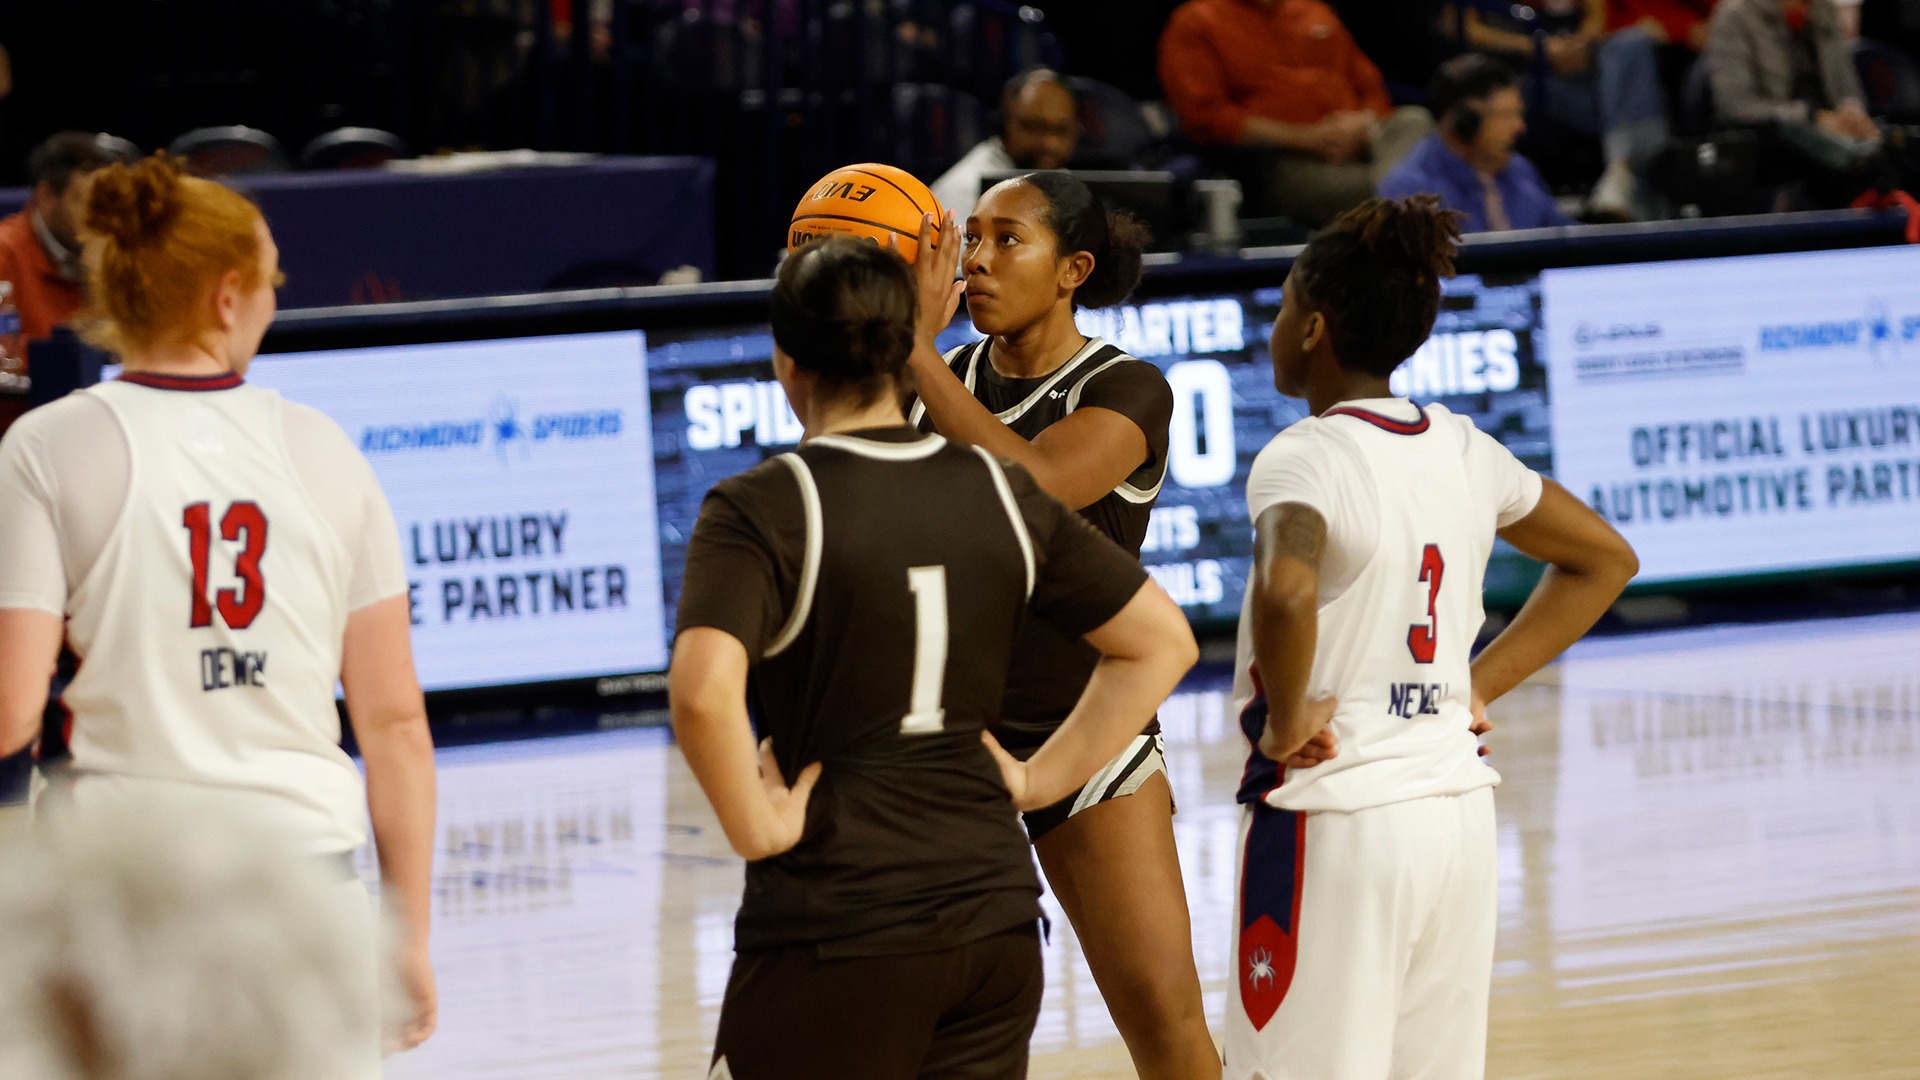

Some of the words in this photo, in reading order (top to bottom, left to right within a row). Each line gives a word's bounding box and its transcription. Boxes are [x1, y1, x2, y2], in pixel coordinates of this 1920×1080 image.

[1632, 418, 1784, 466] OFFICIAL
[1590, 472, 1810, 525] AUTOMOTIVE
[1827, 460, 1920, 506] PART
[183, 501, 268, 629] 13
[411, 511, 567, 565] LUXURY
[442, 567, 628, 624] PARTNER
[1407, 543, 1445, 664] 3
[900, 565, 949, 735] 1
